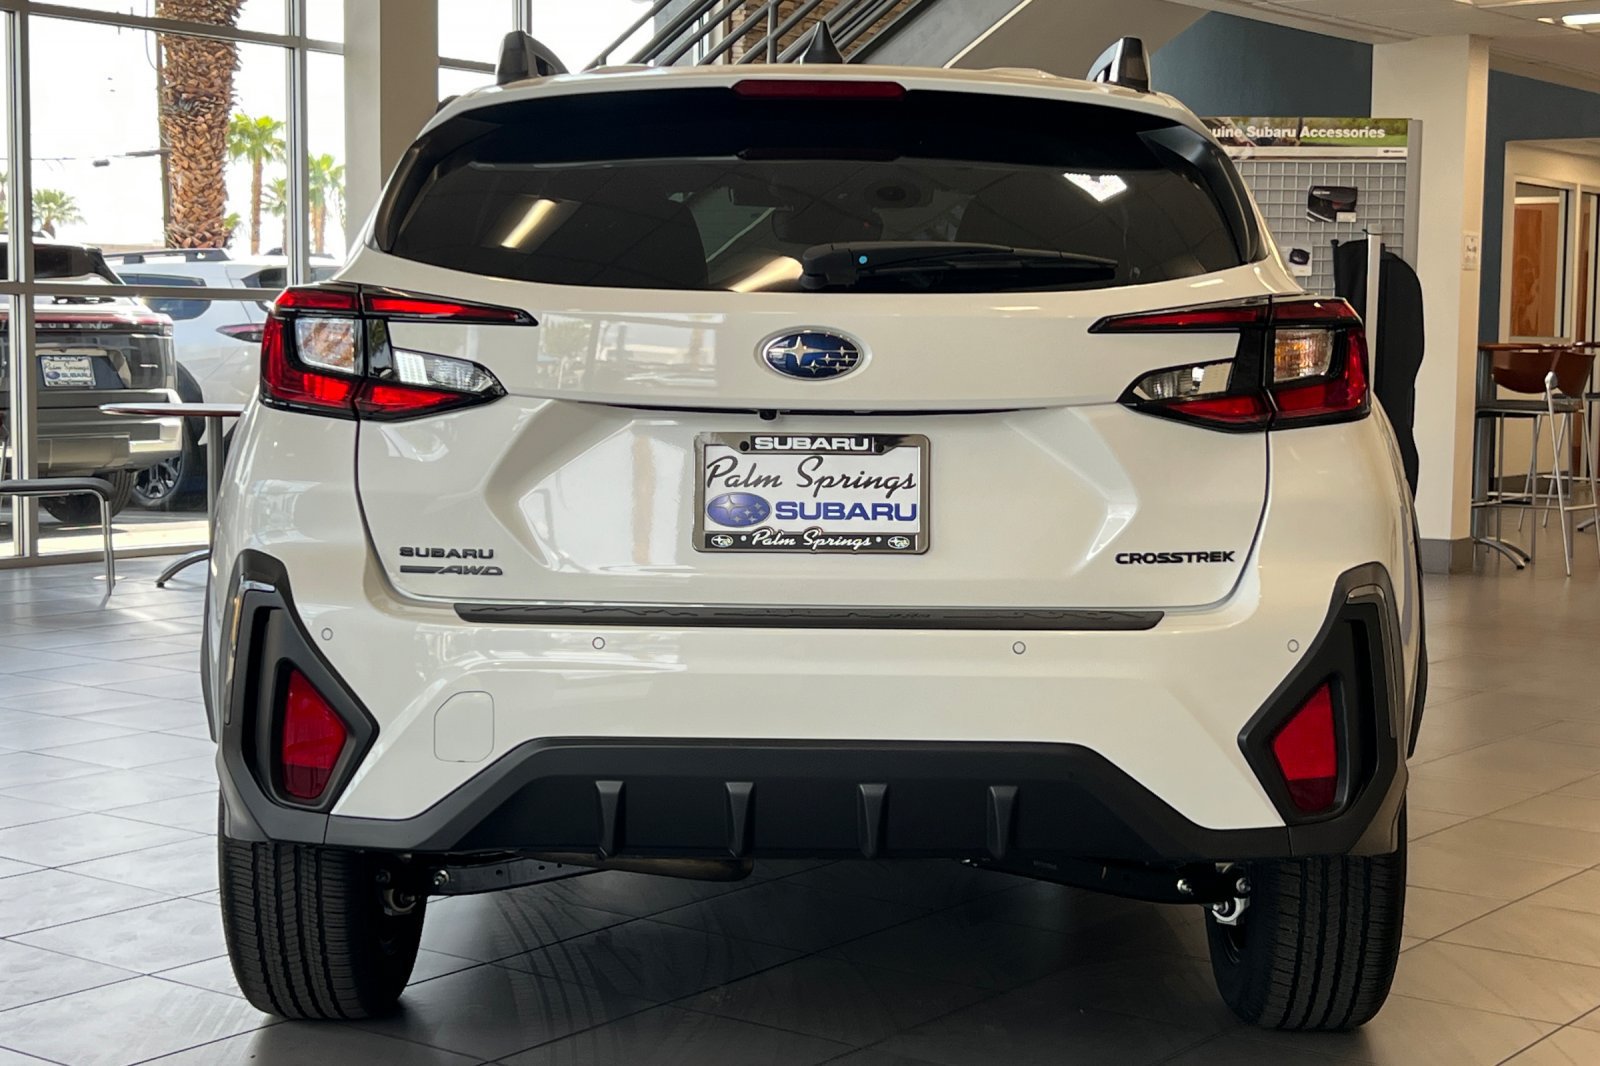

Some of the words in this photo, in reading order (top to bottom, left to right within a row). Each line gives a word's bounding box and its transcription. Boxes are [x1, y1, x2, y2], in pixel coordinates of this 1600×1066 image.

[1246, 125, 1297, 138] Subaru
[1300, 126, 1386, 138] Accessories
[754, 436, 869, 451] SUBARU
[706, 455, 783, 489] Palm
[796, 455, 917, 498] Springs
[775, 501, 917, 521] SUBARU
[751, 528, 796, 546] Palm
[803, 528, 872, 549] Springs
[399, 546, 494, 559] SUBARU
[1115, 551, 1235, 565] CROSSTREK
[438, 565, 503, 576] AWD
